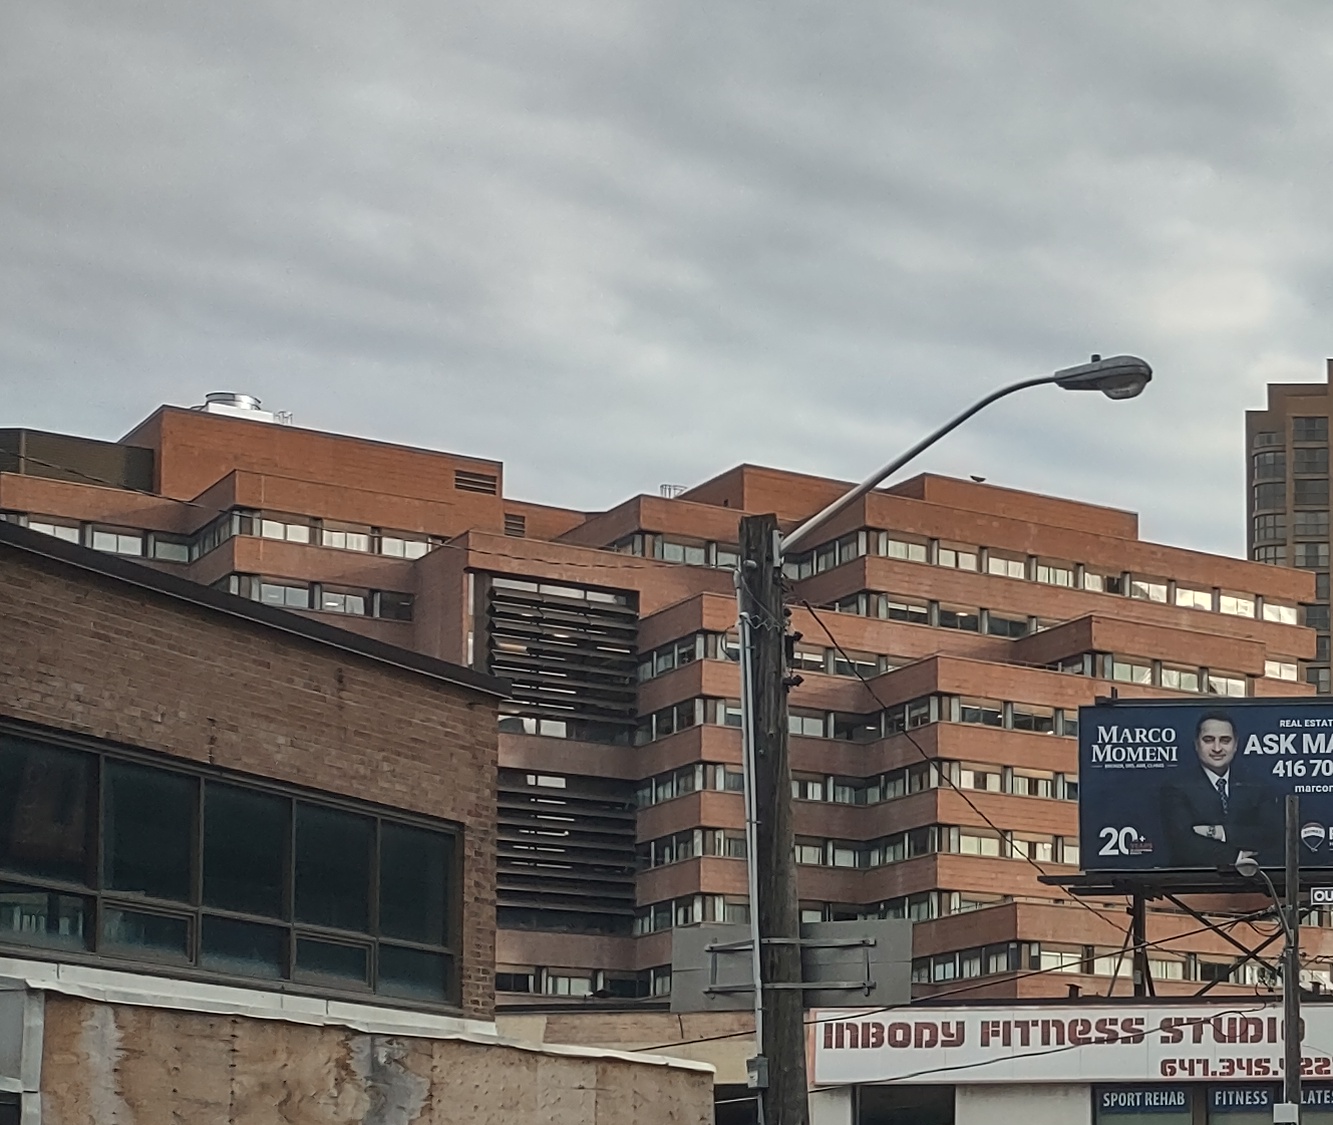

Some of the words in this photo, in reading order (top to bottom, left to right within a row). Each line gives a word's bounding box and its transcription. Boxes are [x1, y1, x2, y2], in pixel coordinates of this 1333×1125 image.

[1280, 719, 1302, 728] REAL
[1097, 726, 1176, 744] MARCO
[1243, 733, 1298, 755] ASK
[1091, 744, 1178, 763] MOMENI
[1272, 760, 1307, 777] 416
[823, 1020, 966, 1049] INBODY
[980, 1016, 1146, 1047] FITNESS
[1103, 1091, 1143, 1107] SPORT
[1144, 1090, 1185, 1107] REHAB
[1214, 1090, 1268, 1106] FITNESS
